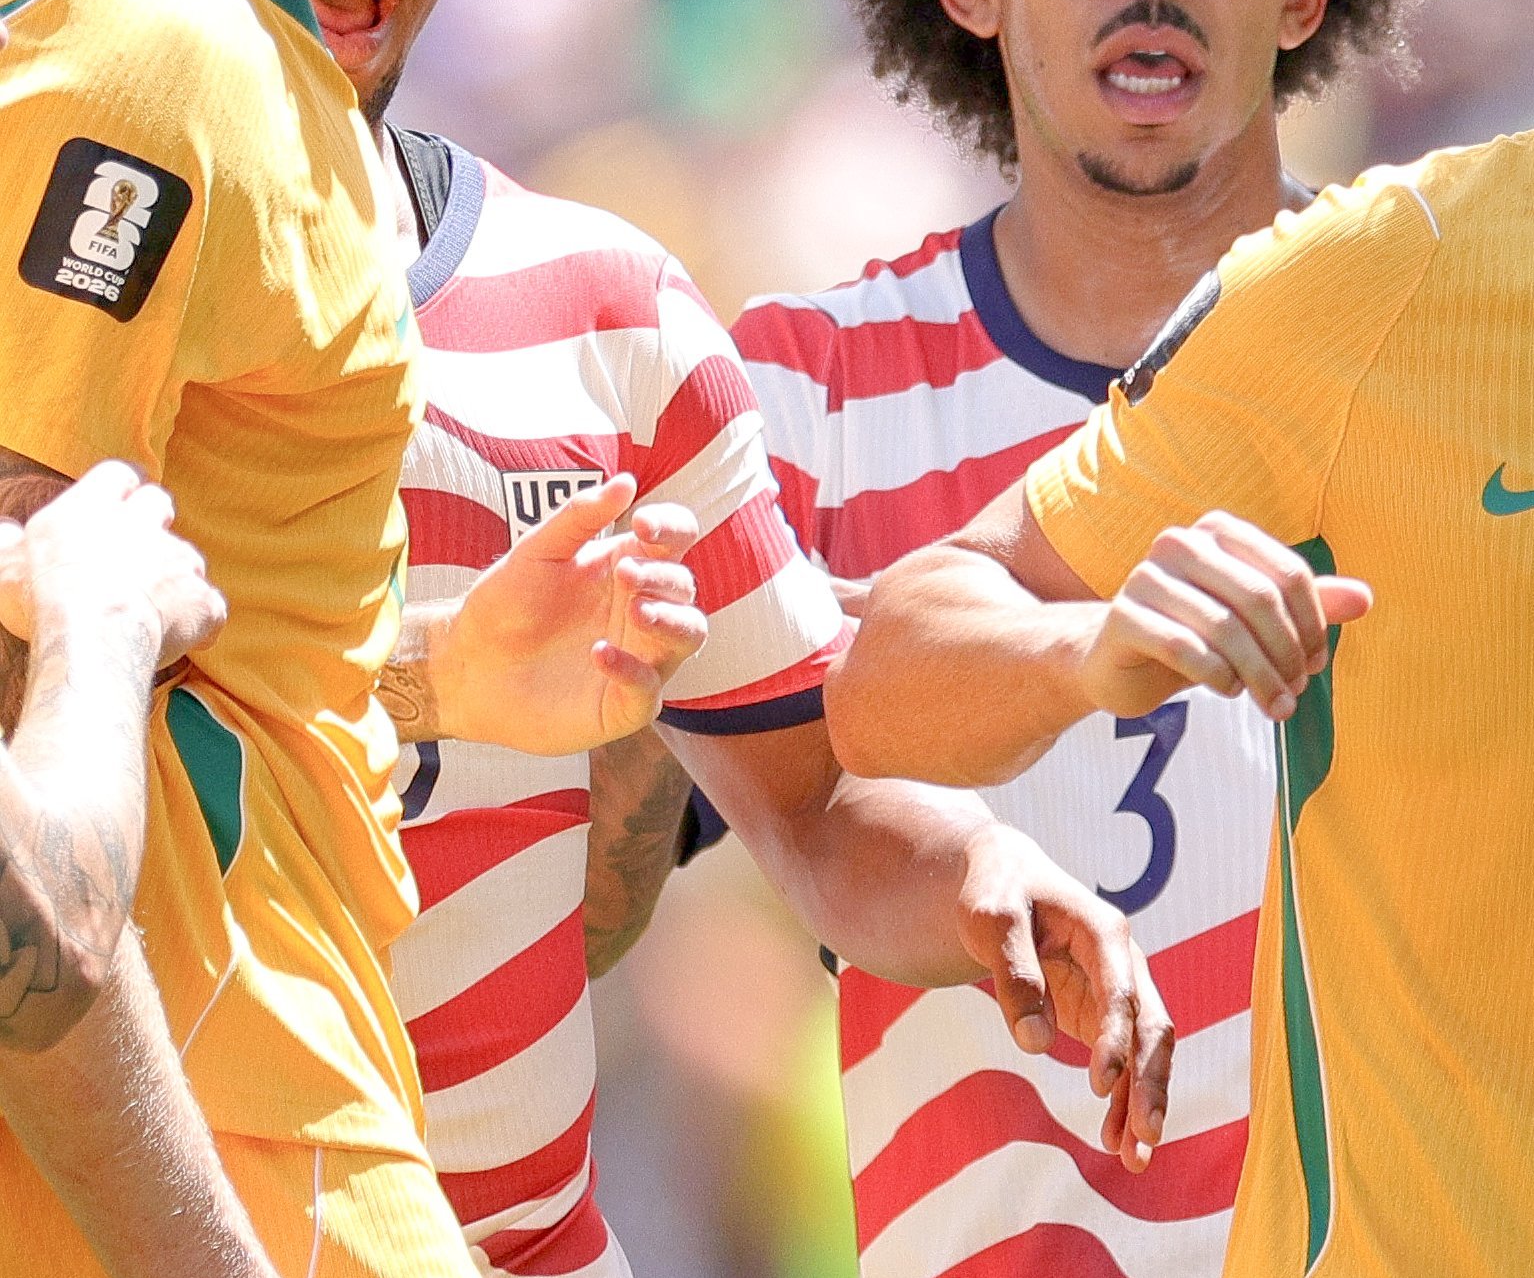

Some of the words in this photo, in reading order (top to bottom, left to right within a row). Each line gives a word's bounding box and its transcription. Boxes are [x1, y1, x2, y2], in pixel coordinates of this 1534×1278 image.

[88, 240, 118, 259] FIFA
[54, 268, 121, 302] 2026
[62, 257, 103, 277] WORLD
[105, 270, 125, 286] CUP
[1094, 700, 1189, 916] 3
